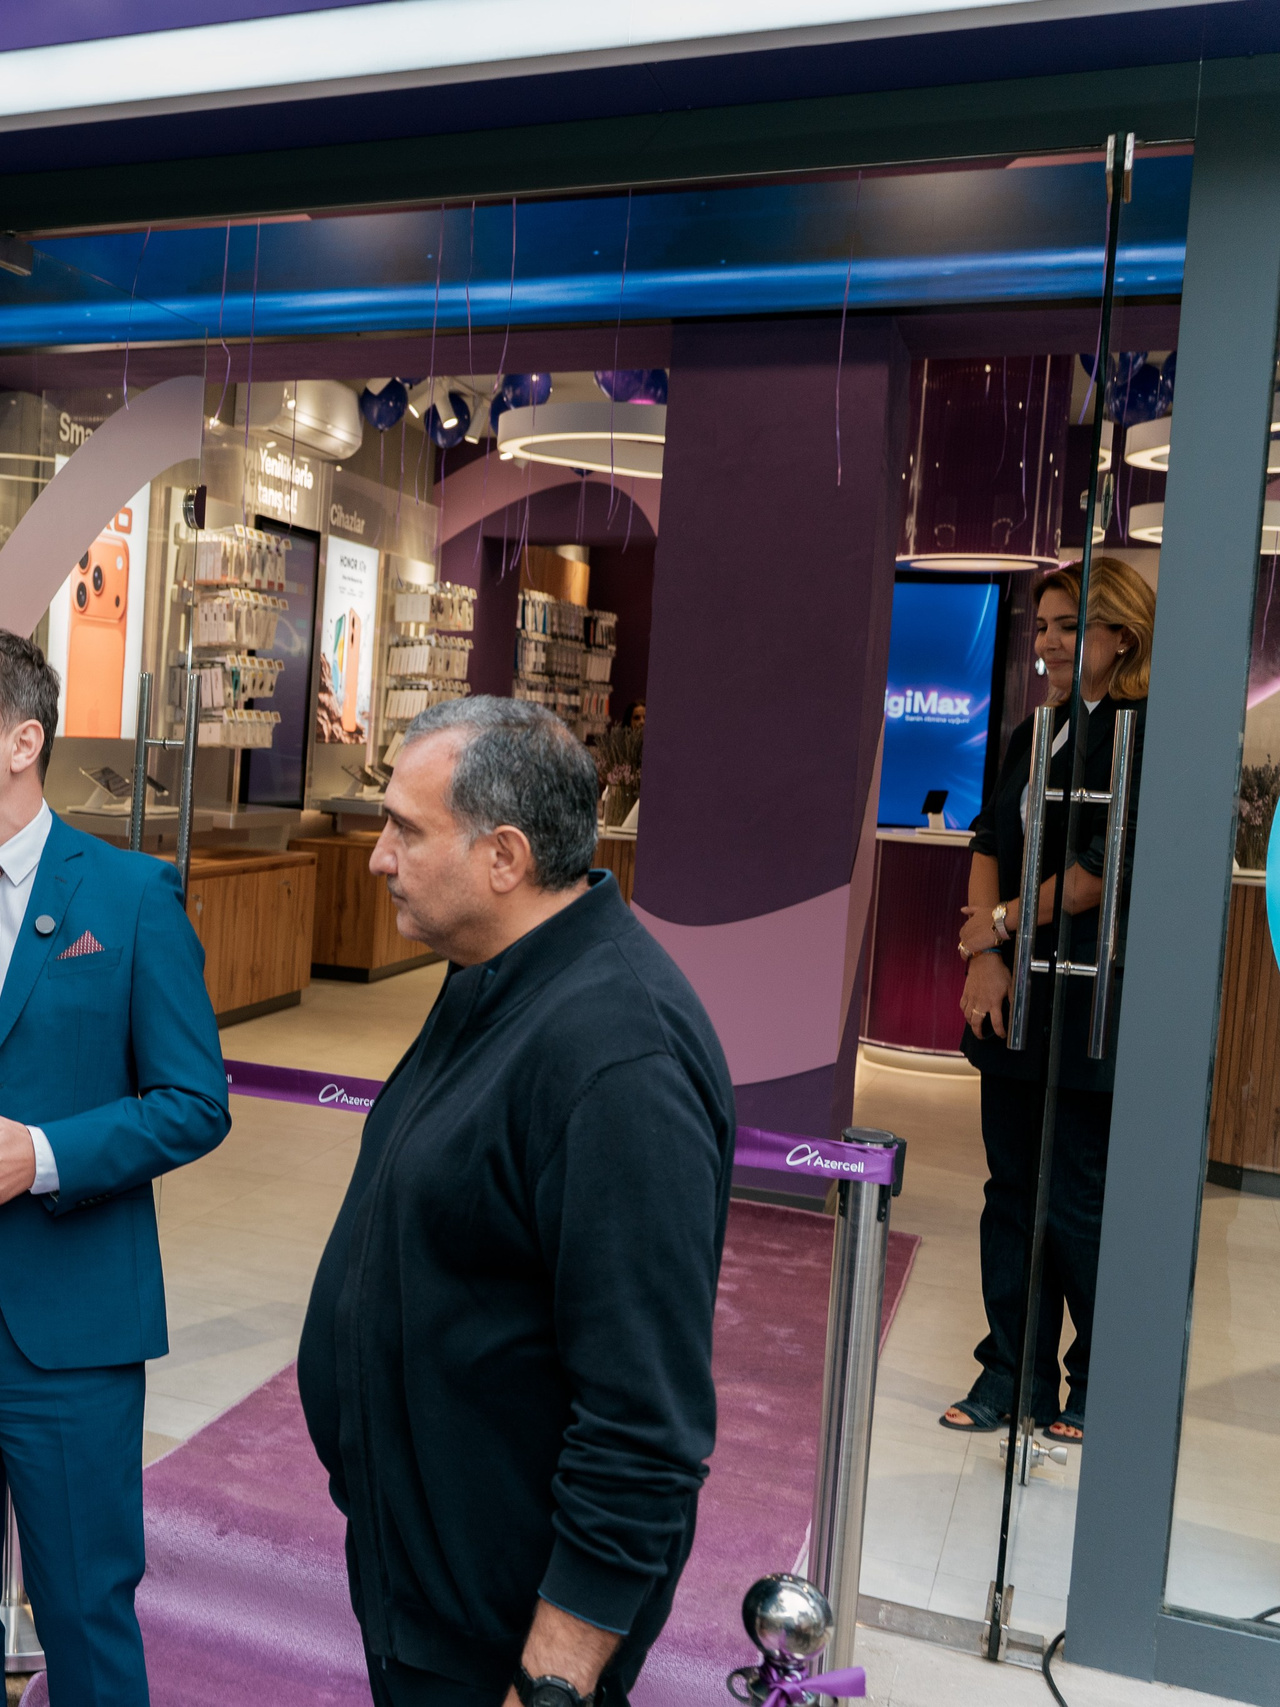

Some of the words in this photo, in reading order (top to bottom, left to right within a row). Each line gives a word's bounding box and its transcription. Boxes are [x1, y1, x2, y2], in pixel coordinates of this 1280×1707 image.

[330, 503, 366, 535] Cihazlar
[340, 1093, 375, 1108] Azerce
[813, 1155, 864, 1174] Azercell
